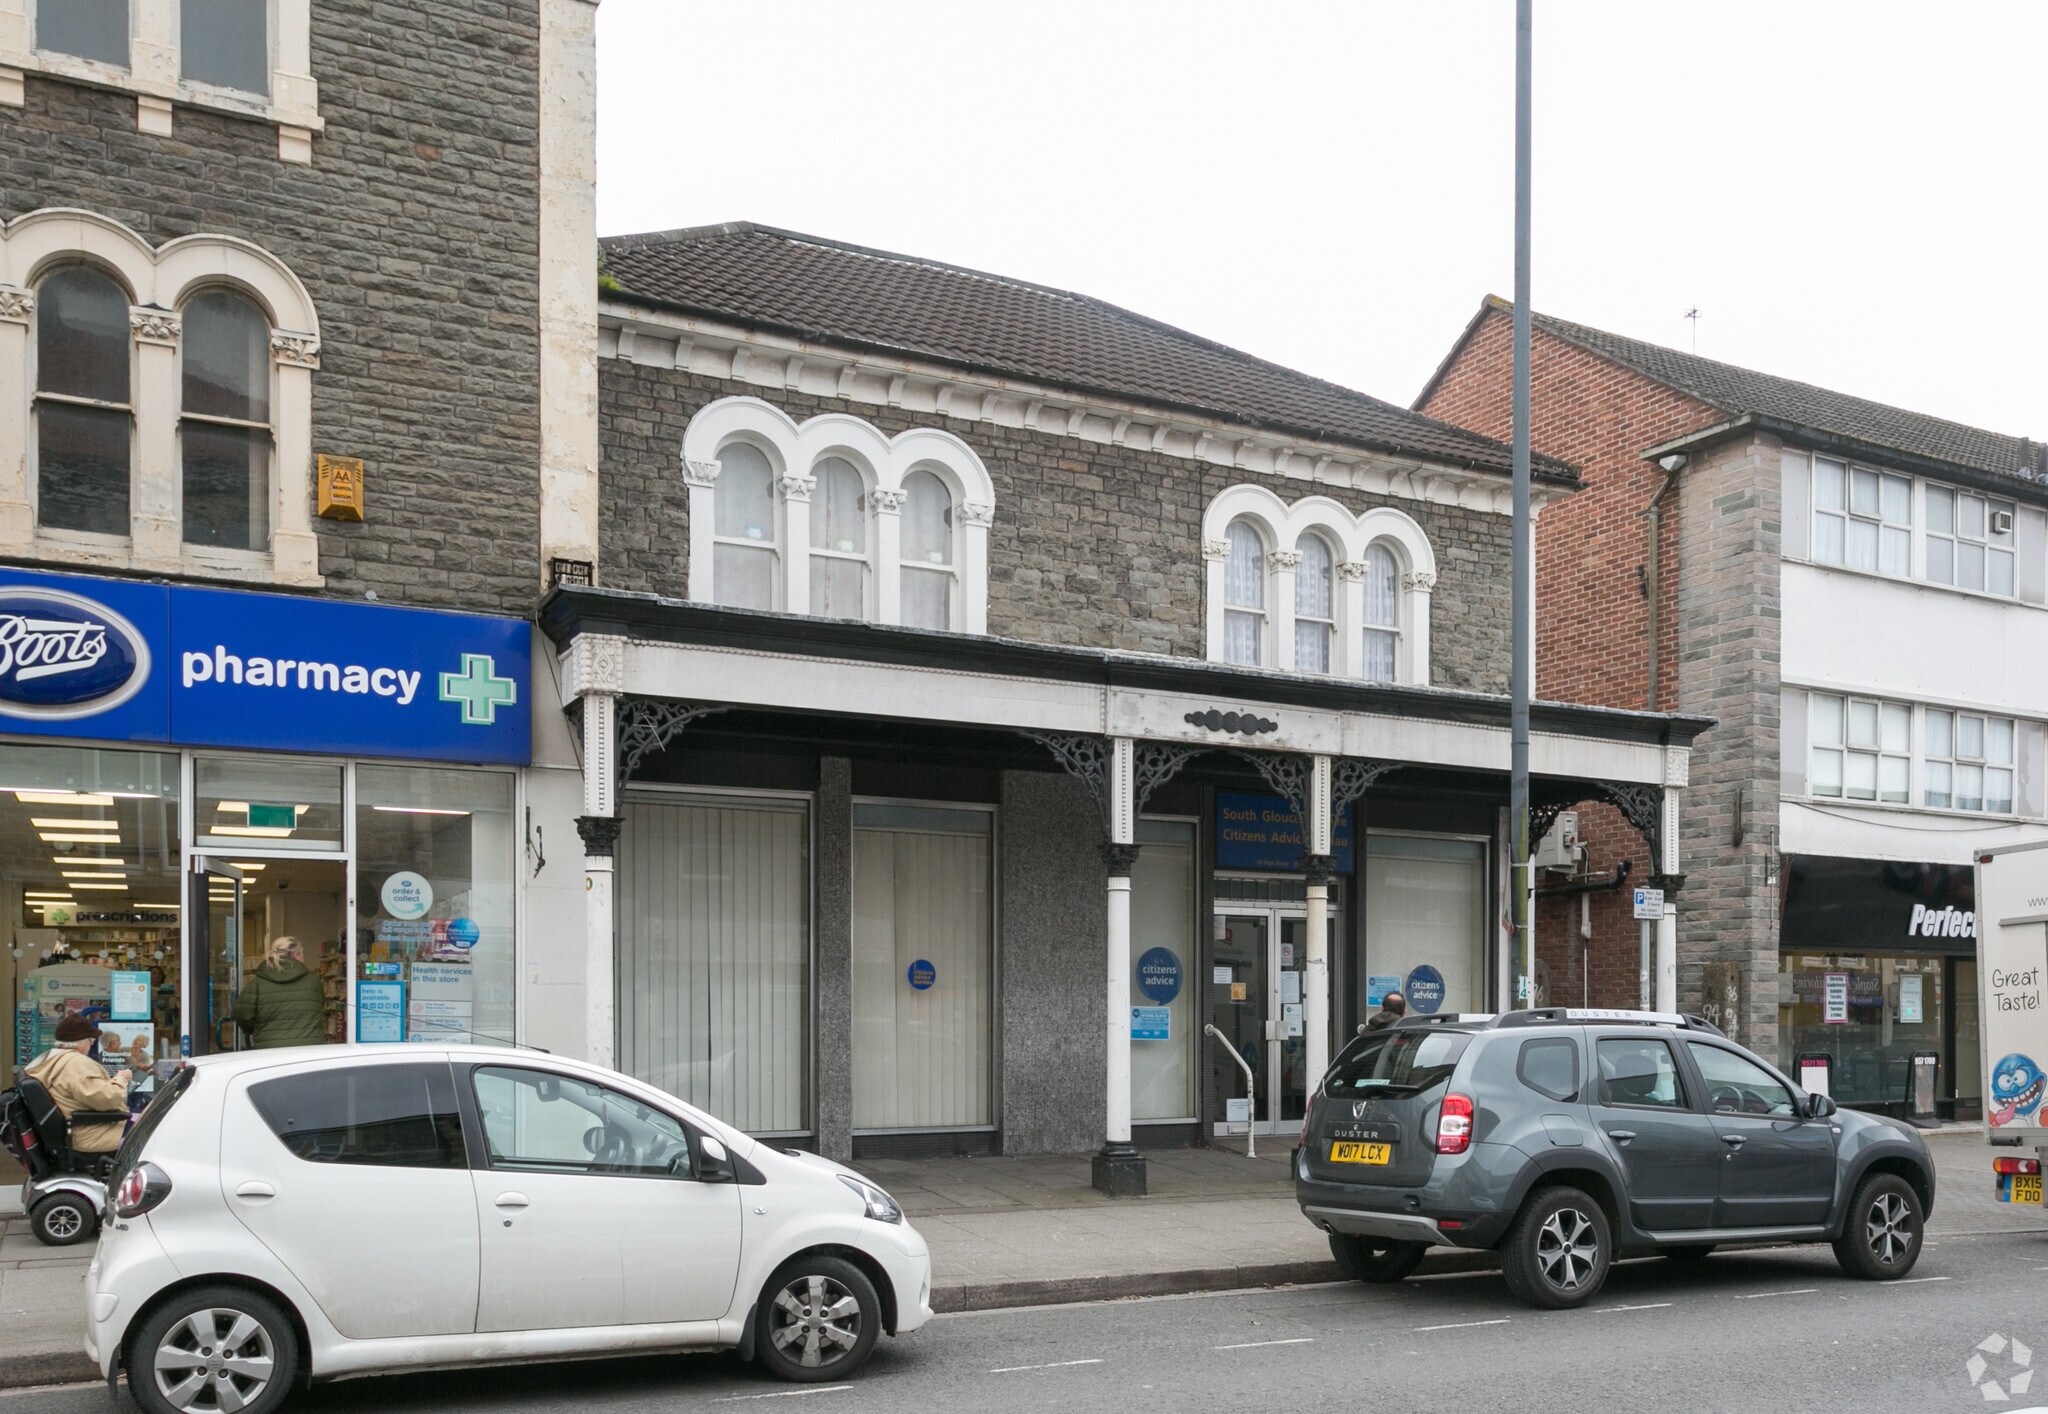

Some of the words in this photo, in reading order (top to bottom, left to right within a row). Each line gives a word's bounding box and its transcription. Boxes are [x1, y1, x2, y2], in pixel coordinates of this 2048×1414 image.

[334, 470, 350, 482] AA
[182, 645, 421, 705] pharmacy
[1222, 808, 1257, 821] South
[1222, 829, 1266, 842] Citizens
[1270, 832, 1301, 844] Advic
[76, 909, 178, 924] prescriptions
[1142, 964, 1176, 974] citizens
[1146, 976, 1174, 985] advice
[1992, 966, 2038, 988] Great
[1412, 981, 1440, 990] citizens
[1414, 990, 1438, 999] advice
[1994, 990, 2040, 1011] Taste!
[1334, 1130, 1378, 1138] DUSTER
[1338, 1144, 1360, 1158] WO17
[1361, 1144, 1383, 1160] LCX
[2015, 1176, 2042, 1188] BX15
